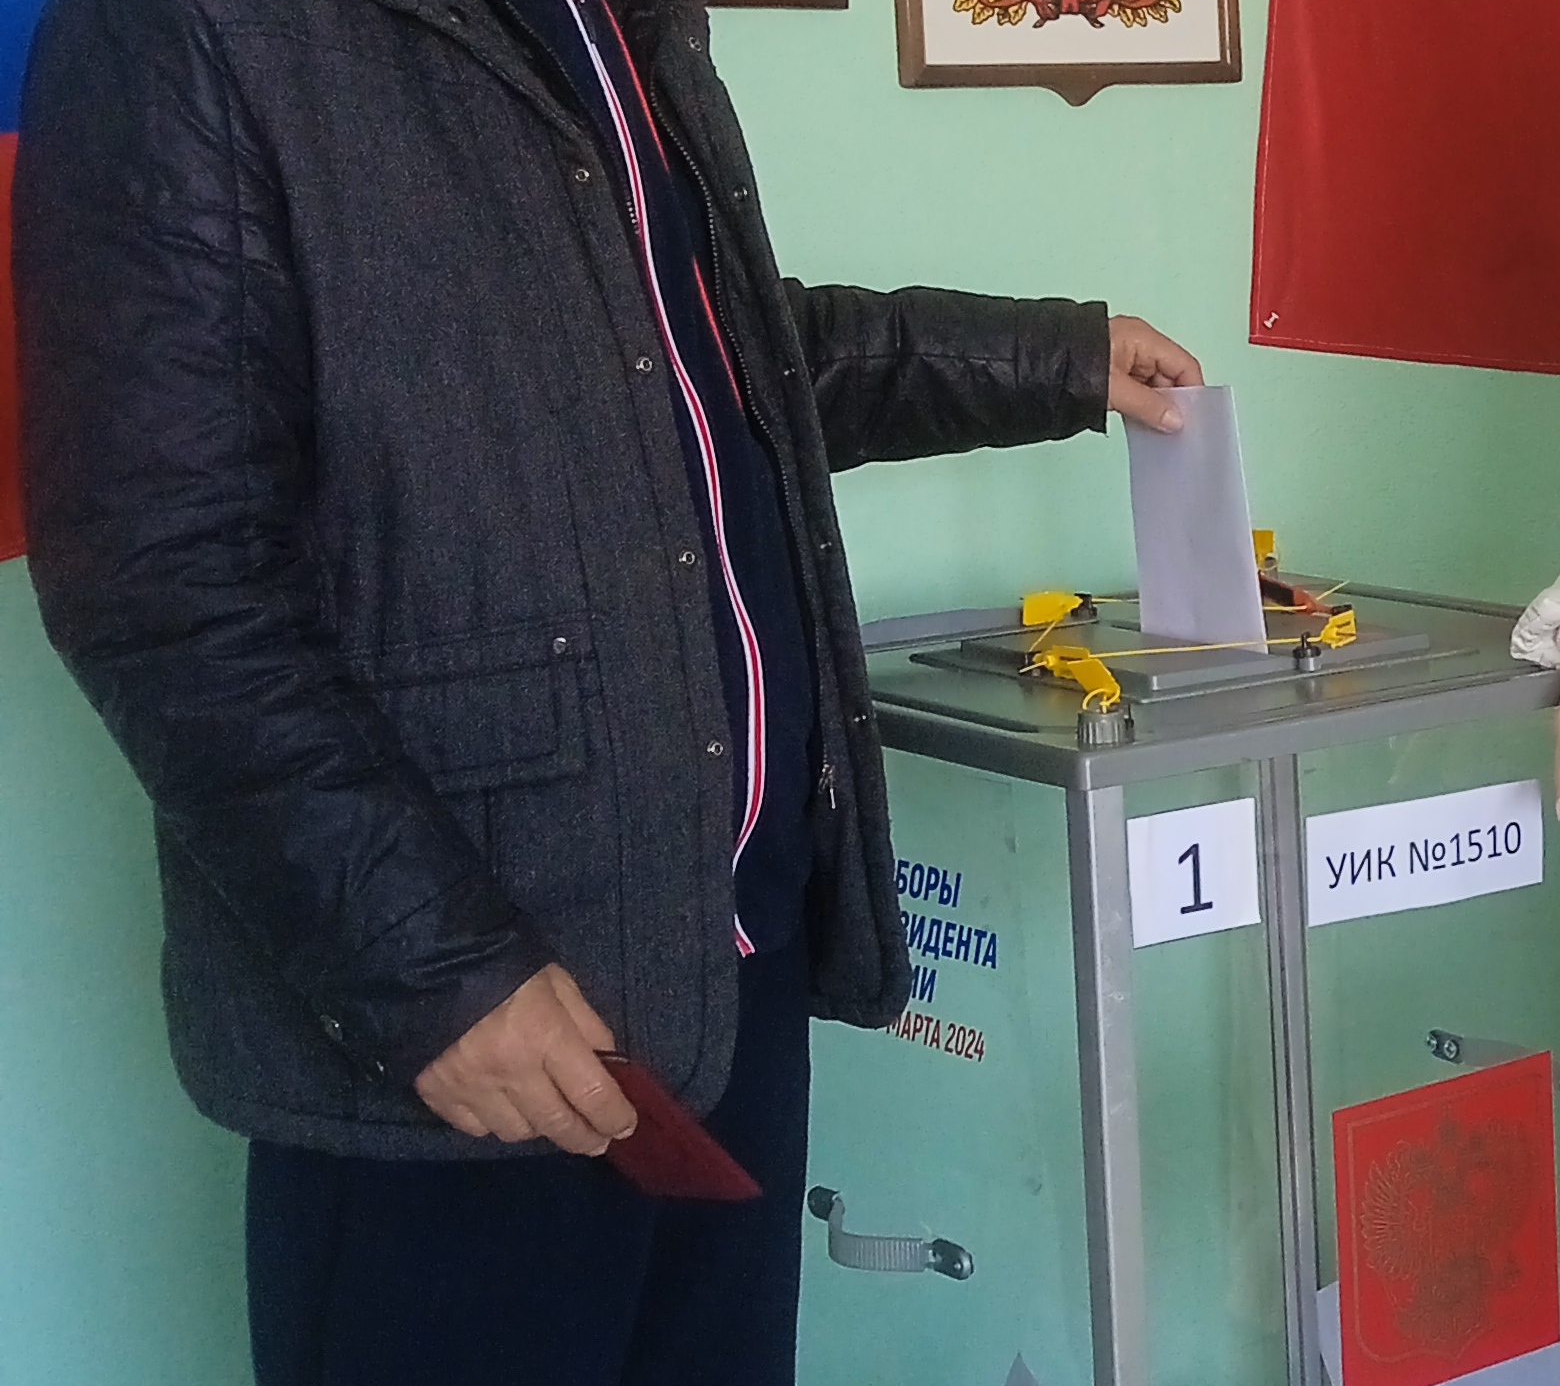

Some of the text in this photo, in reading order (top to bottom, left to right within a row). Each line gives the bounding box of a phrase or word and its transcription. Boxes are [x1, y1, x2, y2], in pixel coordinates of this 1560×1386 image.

[897, 859, 962, 908] БОРЫ
[1178, 843, 1213, 915] 1
[1325, 821, 1522, 889] УИК №1510
[900, 910, 997, 970] ИДЕНТА
[944, 1022, 985, 1064] 2024
